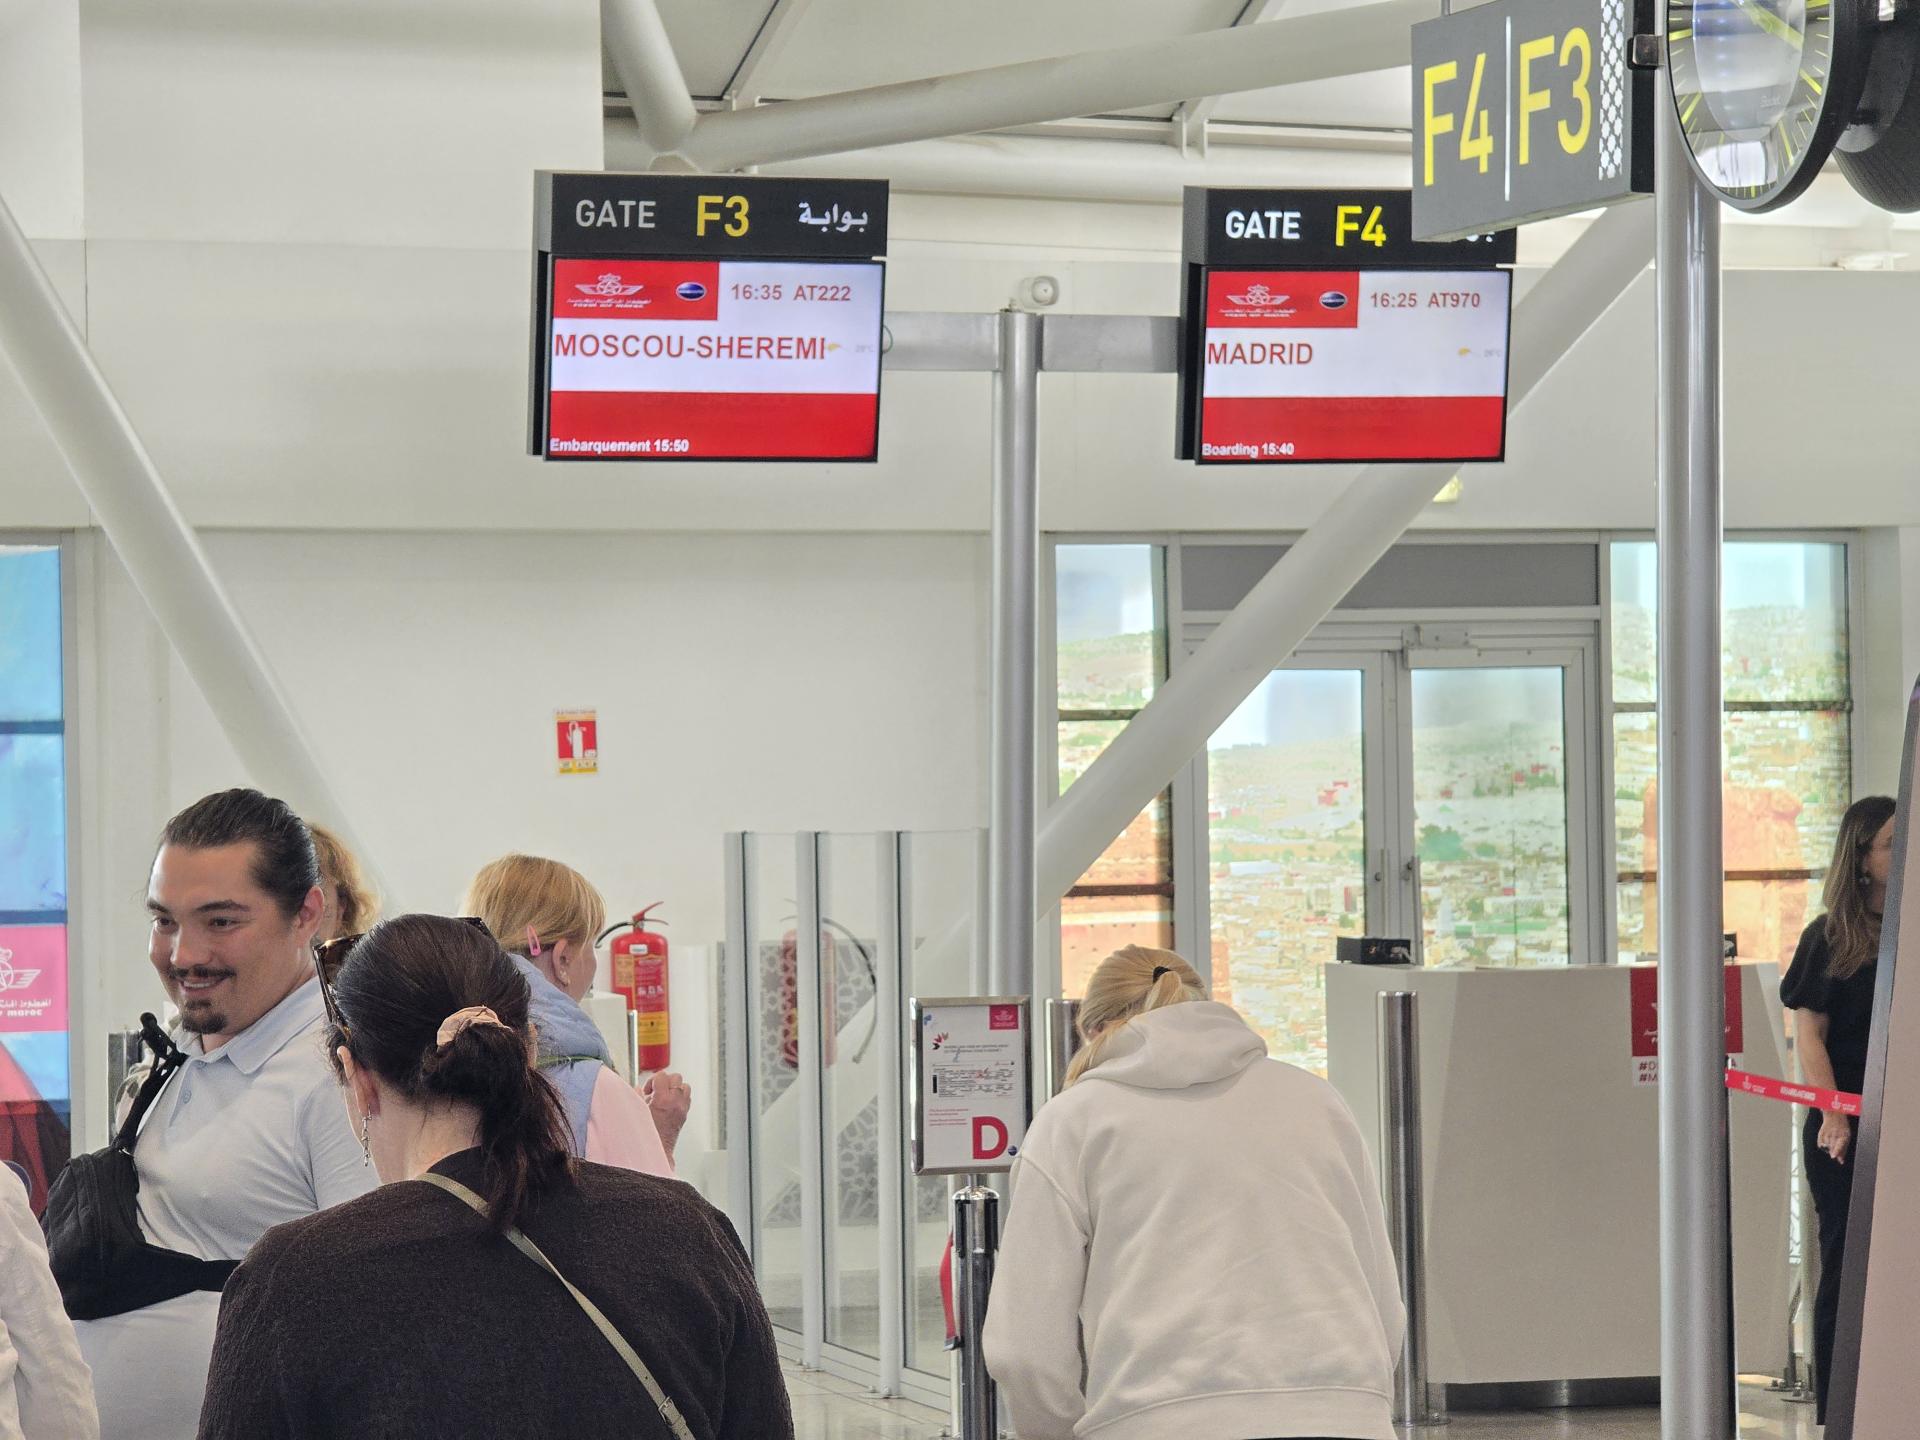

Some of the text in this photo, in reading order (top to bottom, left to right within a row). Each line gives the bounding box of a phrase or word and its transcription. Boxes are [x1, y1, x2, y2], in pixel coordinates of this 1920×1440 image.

[1422, 28, 1592, 187] F4 F3
[575, 196, 750, 237] GATE F3
[798, 202, 868, 233] بوابة
[1225, 206, 1387, 247] GATE F4
[731, 284, 852, 302] 16:35 AT222
[1370, 293, 1481, 308] 16:25 AT970
[554, 334, 826, 360] MOSCOU-SHEREMI
[1208, 343, 1313, 365] MADRID
[550, 438, 689, 455] Embarquement 15:50
[1202, 442, 1295, 459] Boarding 15:40
[972, 1117, 1009, 1160] D
